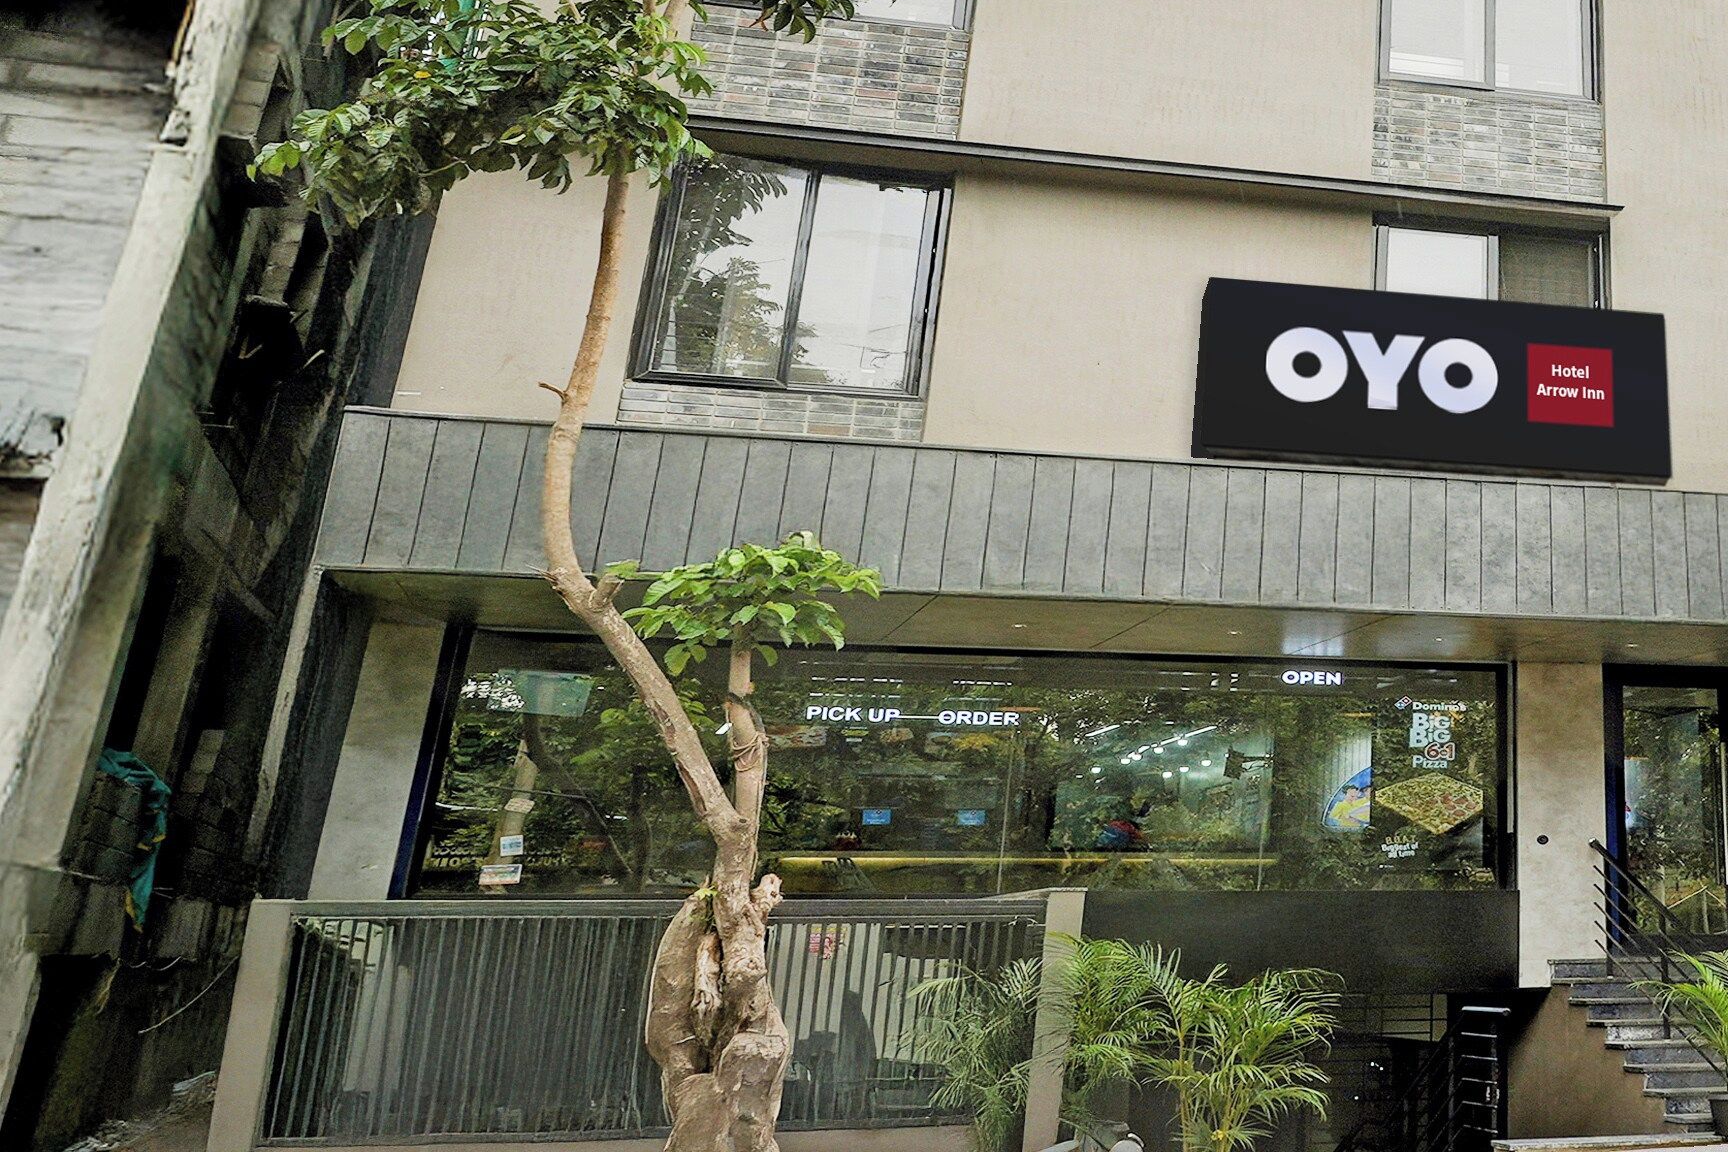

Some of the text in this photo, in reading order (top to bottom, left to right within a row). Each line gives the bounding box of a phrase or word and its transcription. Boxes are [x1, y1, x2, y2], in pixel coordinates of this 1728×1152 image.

[1265, 326, 1498, 414] OYO
[1551, 364, 1590, 379] Hotel
[1536, 383, 1605, 400] Arrow Inn
[1281, 670, 1342, 685] OPEN
[806, 706, 1020, 726] PICK UP ORDER
[1412, 755, 1448, 768] Pizza
